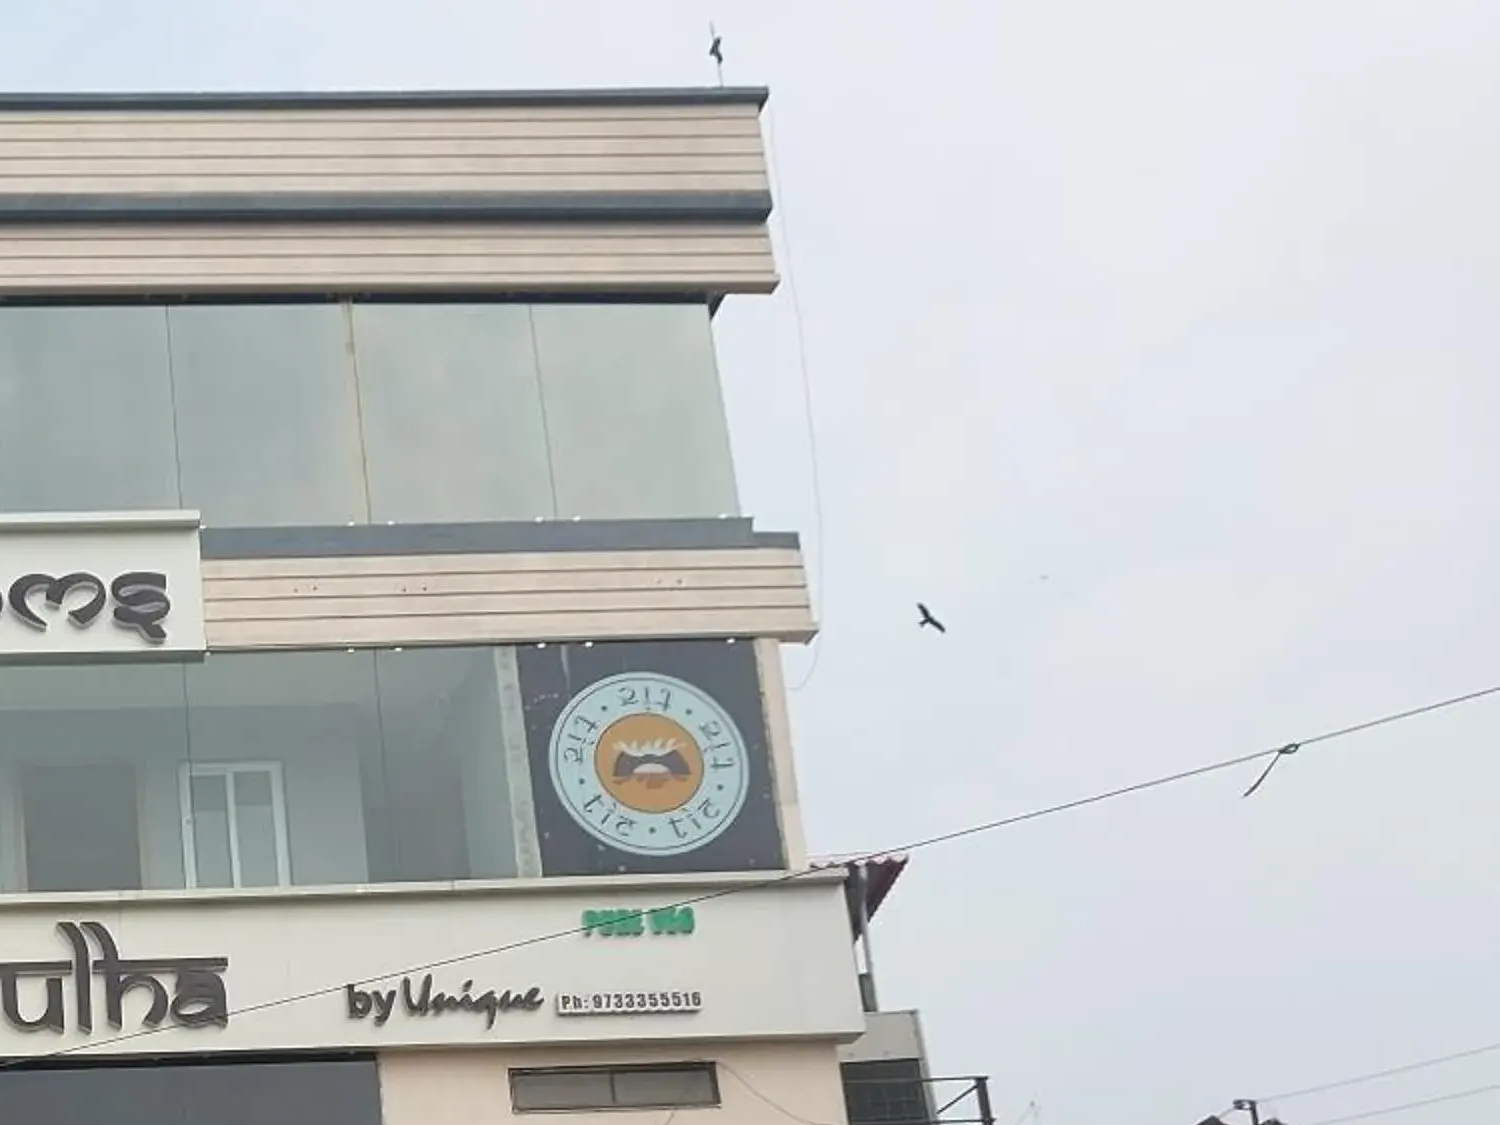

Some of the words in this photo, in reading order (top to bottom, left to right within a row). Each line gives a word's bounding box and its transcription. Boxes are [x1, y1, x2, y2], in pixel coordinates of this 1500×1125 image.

[348, 984, 396, 1026] by
[402, 974, 545, 1030] Unique
[561, 994, 589, 1010] Ph:
